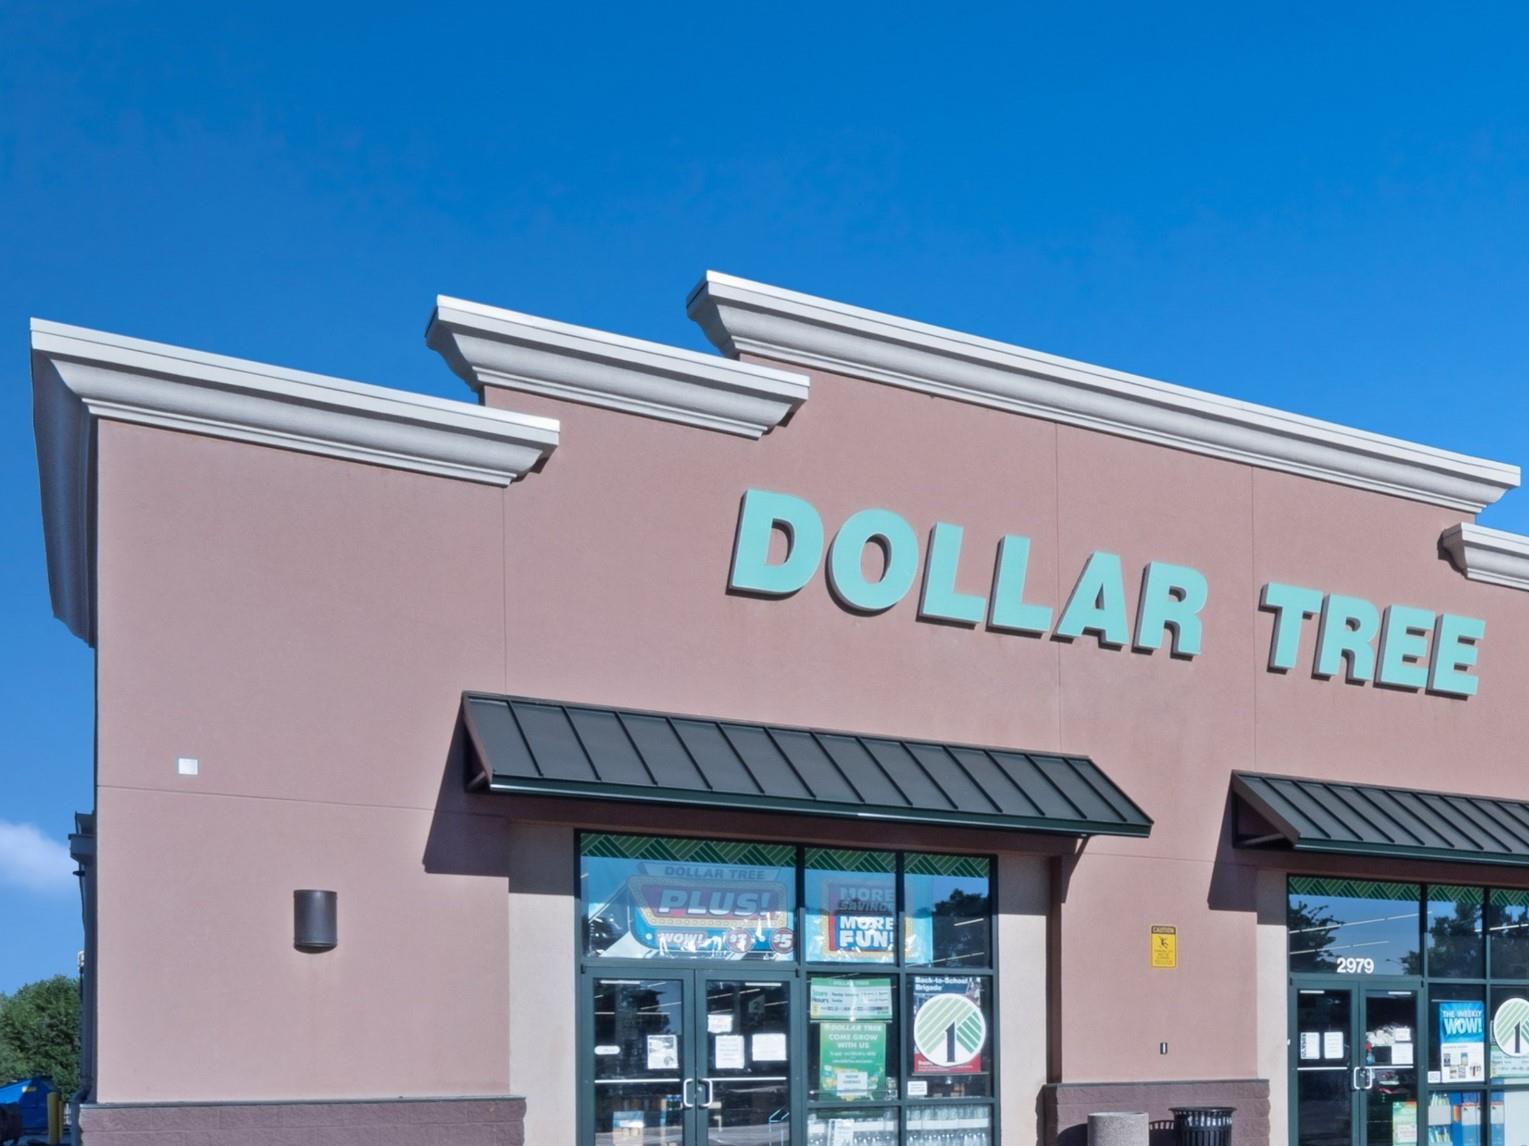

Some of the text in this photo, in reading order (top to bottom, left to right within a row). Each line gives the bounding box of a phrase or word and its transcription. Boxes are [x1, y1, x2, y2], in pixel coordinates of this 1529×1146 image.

[729, 488, 1486, 697] DOLLAR TREE
[664, 865, 766, 880] DOLLAR TREE
[839, 887, 895, 900] MORE
[657, 889, 773, 916] PLUS!
[839, 916, 894, 930] MORE
[773, 933, 793, 948] $5
[839, 930, 894, 948] FUN!
[1336, 957, 1375, 974] 2979
[914, 976, 968, 984] Back-to-School
[914, 983, 943, 992] Brigade
[1443, 1017, 1483, 1035] WOW!
[828, 1033, 879, 1041] COME GROW
[945, 1020, 956, 1063] 1
[1514, 1020, 1521, 1054] 1
[837, 1041, 870, 1049] WITH US
